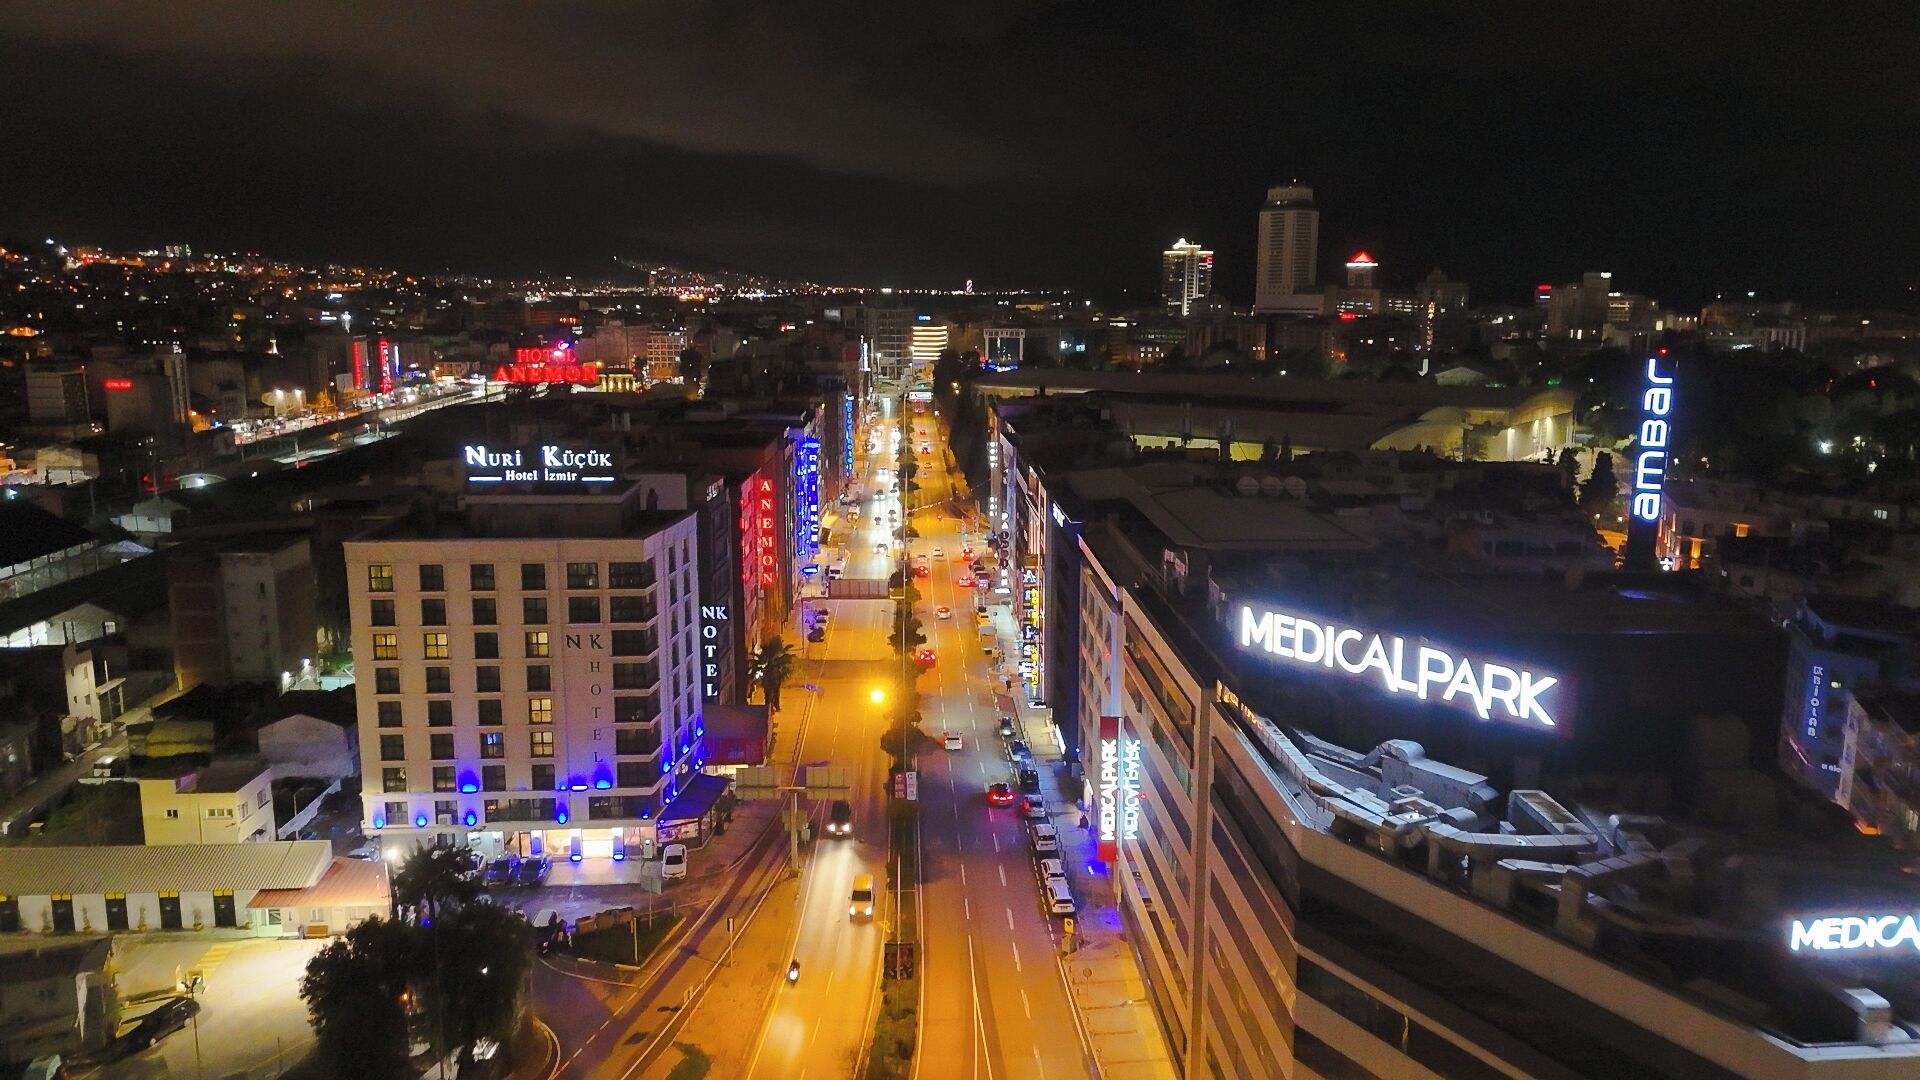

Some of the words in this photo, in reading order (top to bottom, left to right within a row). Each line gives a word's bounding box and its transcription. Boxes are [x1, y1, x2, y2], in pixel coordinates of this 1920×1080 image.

[494, 363, 597, 382] ANEMON
[505, 469, 538, 481] Hotel
[760, 480, 773, 584] ANEMON
[701, 605, 728, 620] NK
[703, 625, 718, 697] OTEL
[1241, 606, 1557, 726] MEDICALPARK
[589, 661, 604, 763] HOTEL
[1100, 739, 1118, 841] MEDICALPARK
